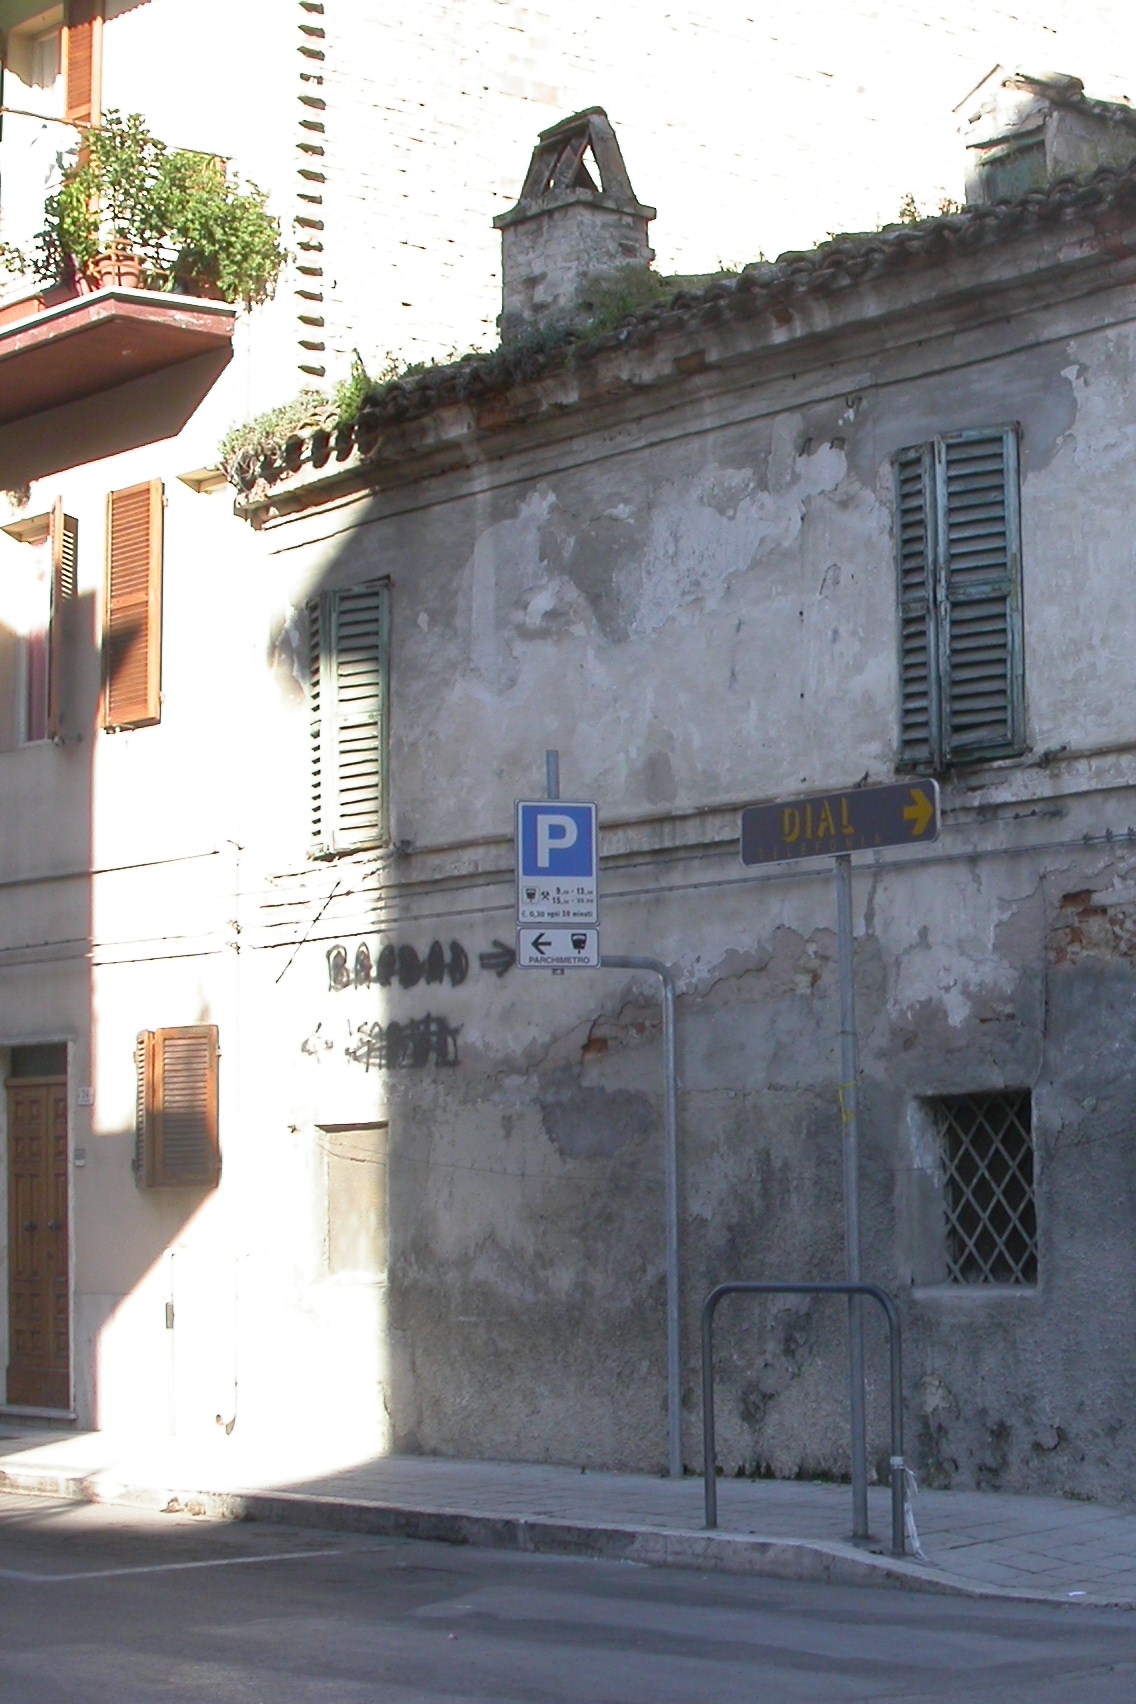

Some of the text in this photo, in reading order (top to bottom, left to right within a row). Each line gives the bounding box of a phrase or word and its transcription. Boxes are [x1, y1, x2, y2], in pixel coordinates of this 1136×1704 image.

[537, 814, 578, 868] P
[783, 797, 855, 843] DIAL
[528, 956, 591, 964] PARCHIMETRO
